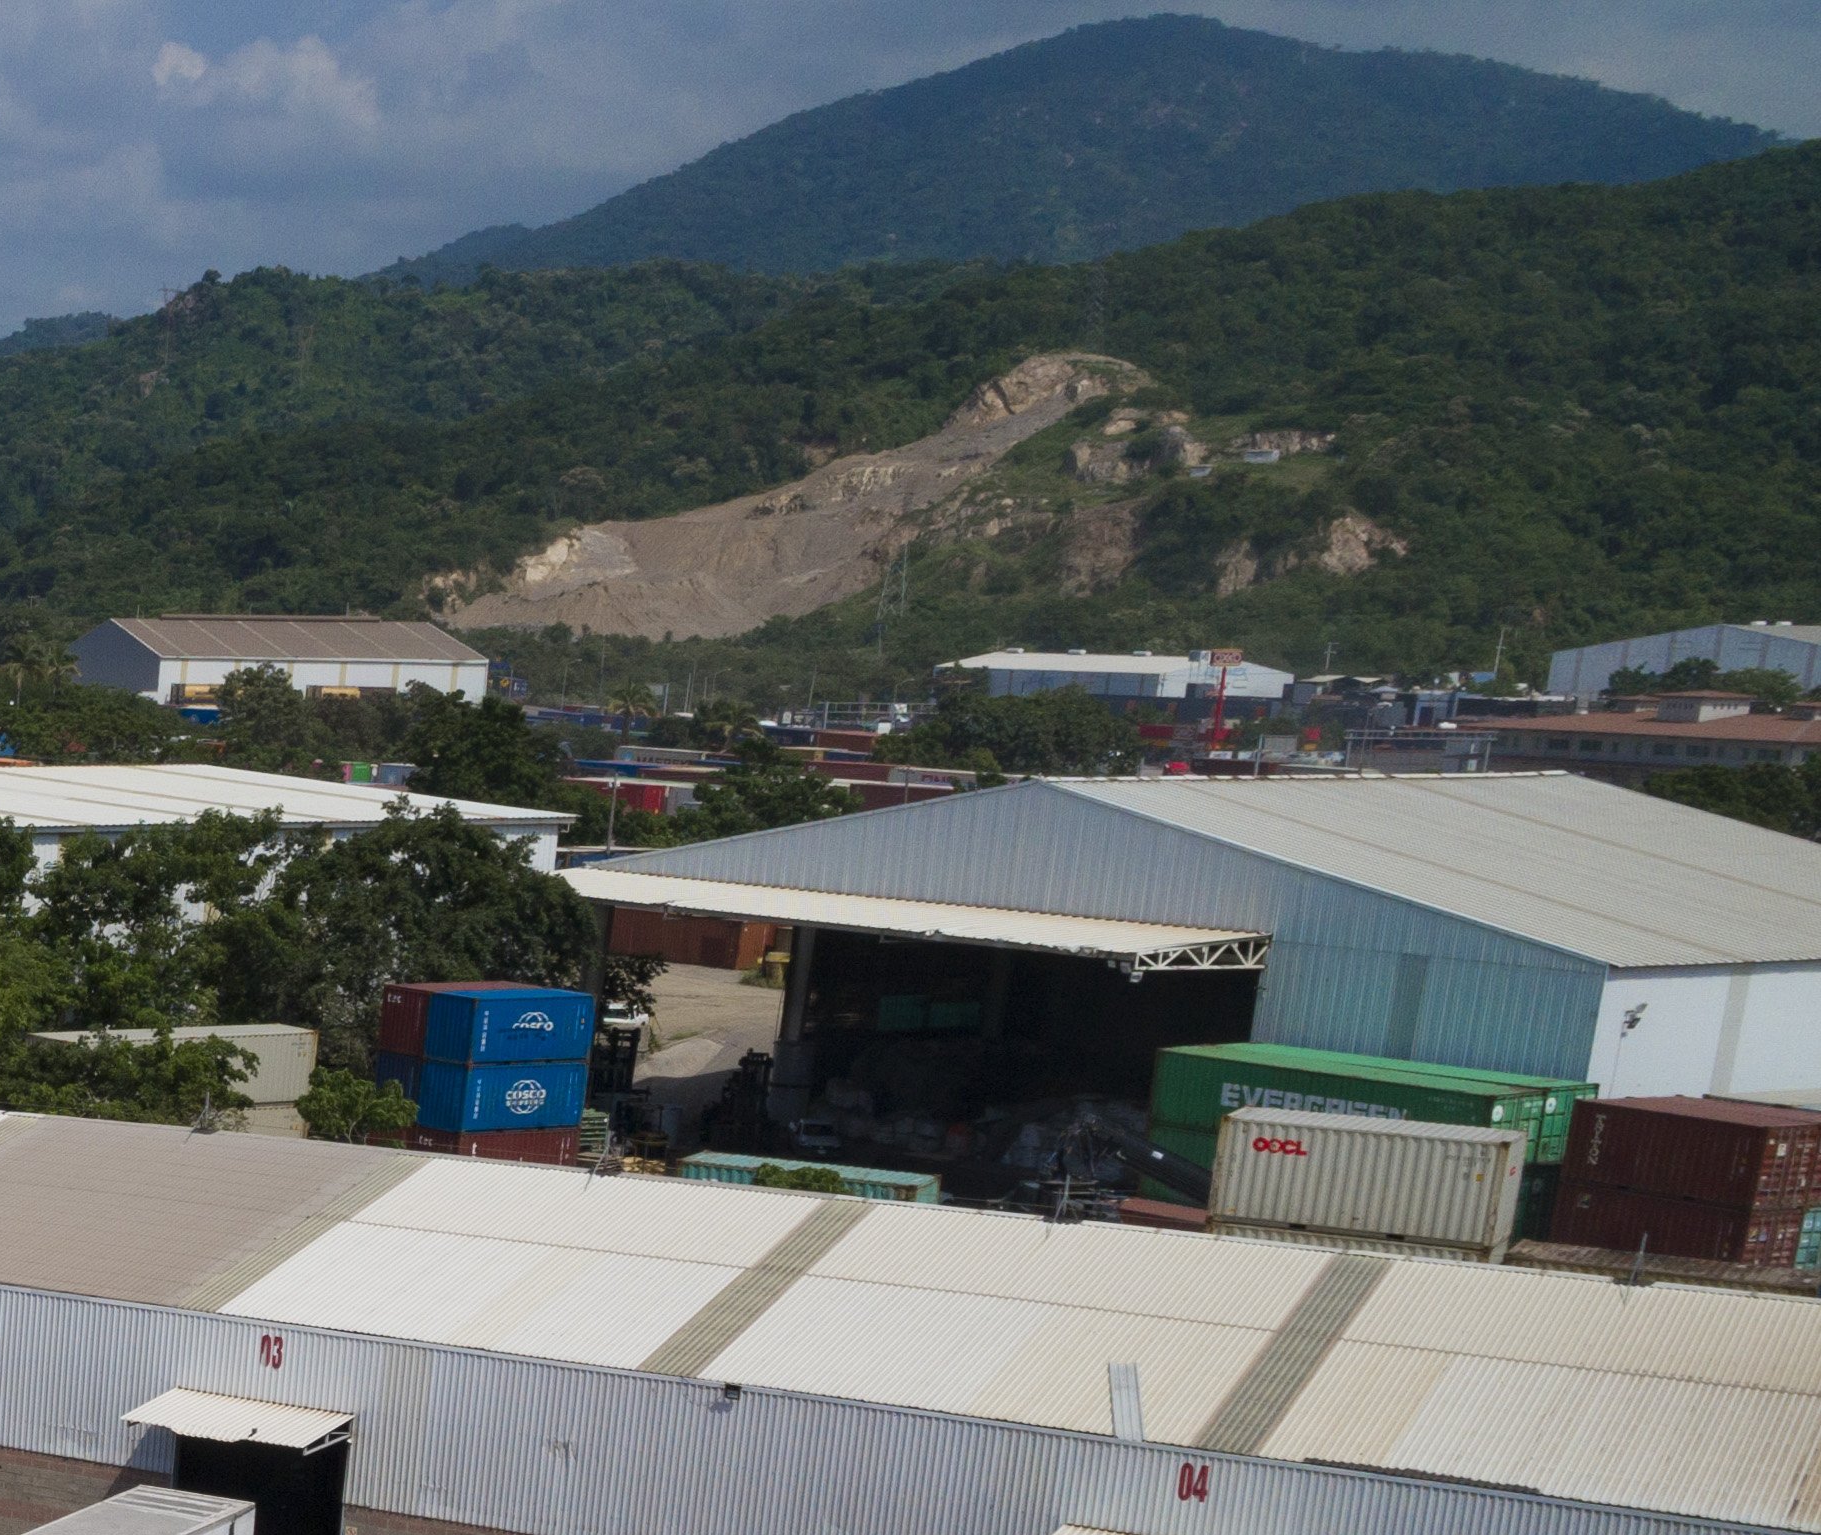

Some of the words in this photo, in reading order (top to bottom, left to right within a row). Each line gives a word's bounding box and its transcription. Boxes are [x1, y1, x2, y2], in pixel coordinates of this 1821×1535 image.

[505, 1088, 547, 1101] COSCO
[1253, 1137, 1308, 1157] OOCL
[259, 1334, 284, 1369] 03
[1177, 1462, 1209, 1503] 04
